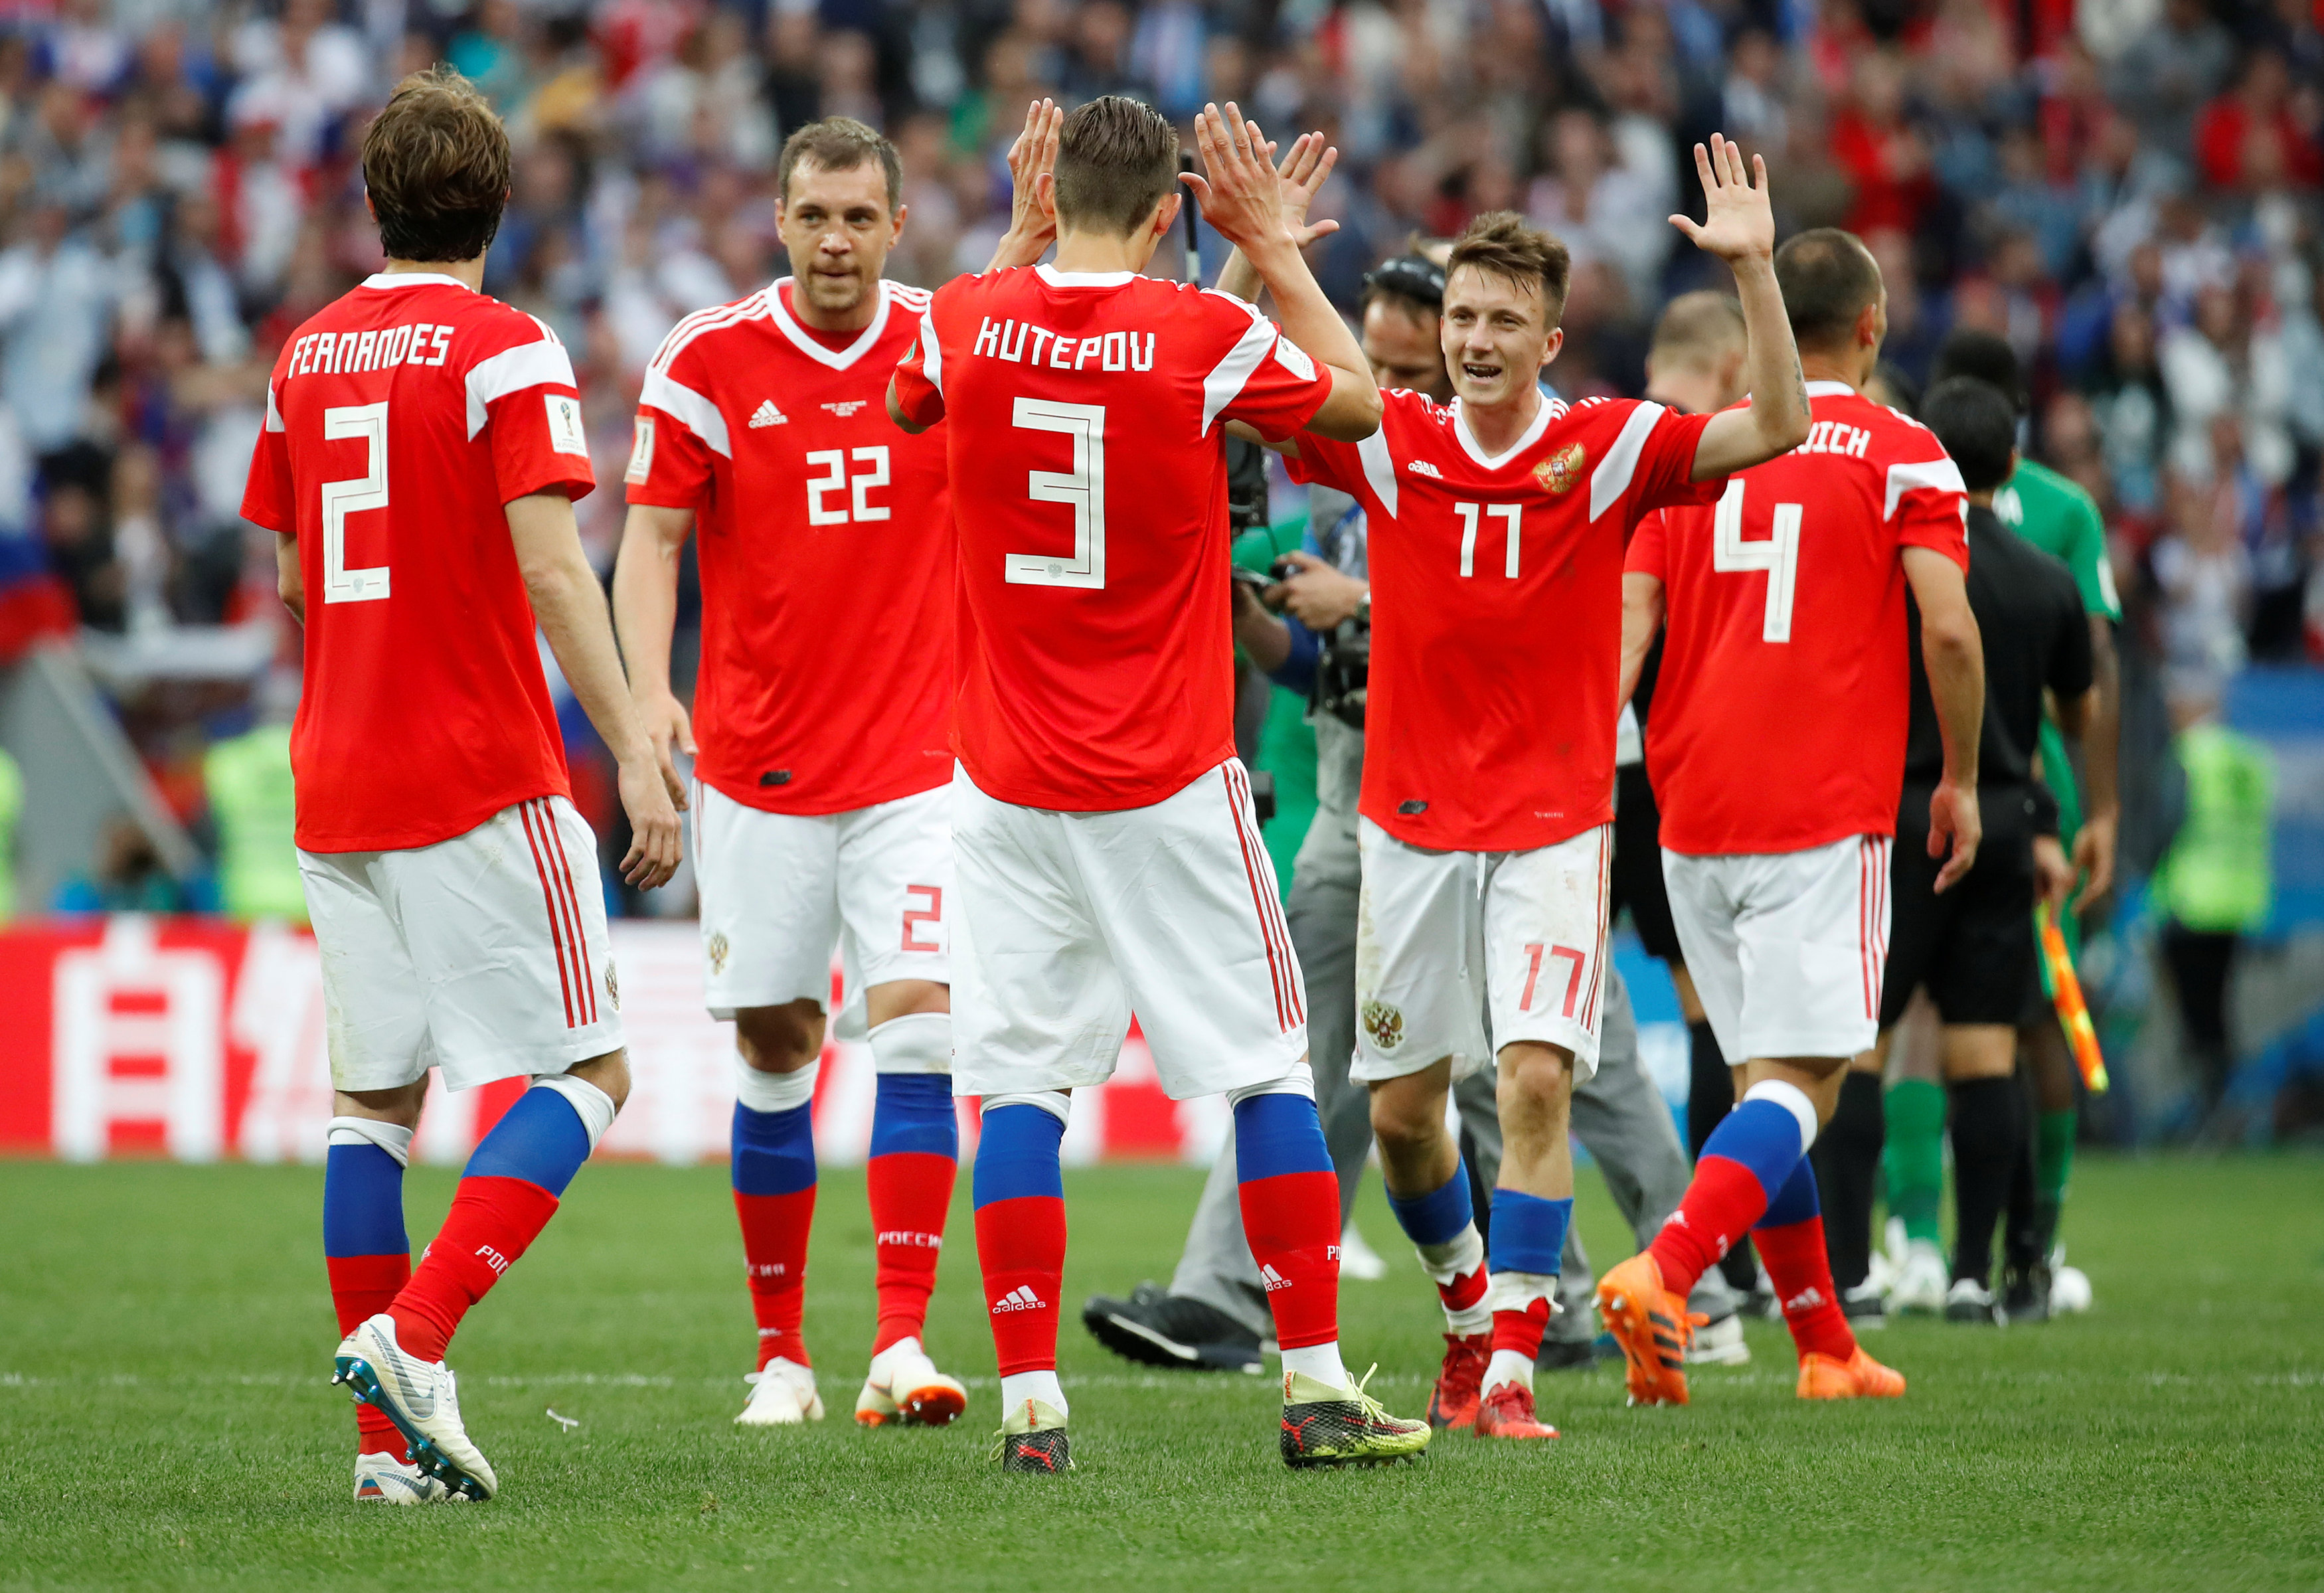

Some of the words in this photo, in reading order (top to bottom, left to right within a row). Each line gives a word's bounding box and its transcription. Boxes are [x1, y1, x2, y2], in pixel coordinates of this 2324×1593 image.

[288, 323, 455, 379] FERNANDES
[973, 316, 1155, 372] KUTEPOV
[321, 400, 390, 604] 2
[806, 446, 891, 526] 22
[1005, 396, 1106, 589] 3
[1713, 479, 1803, 643] 4
[1519, 944, 1586, 1018] 17
[992, 1301, 1046, 1314] adidas
